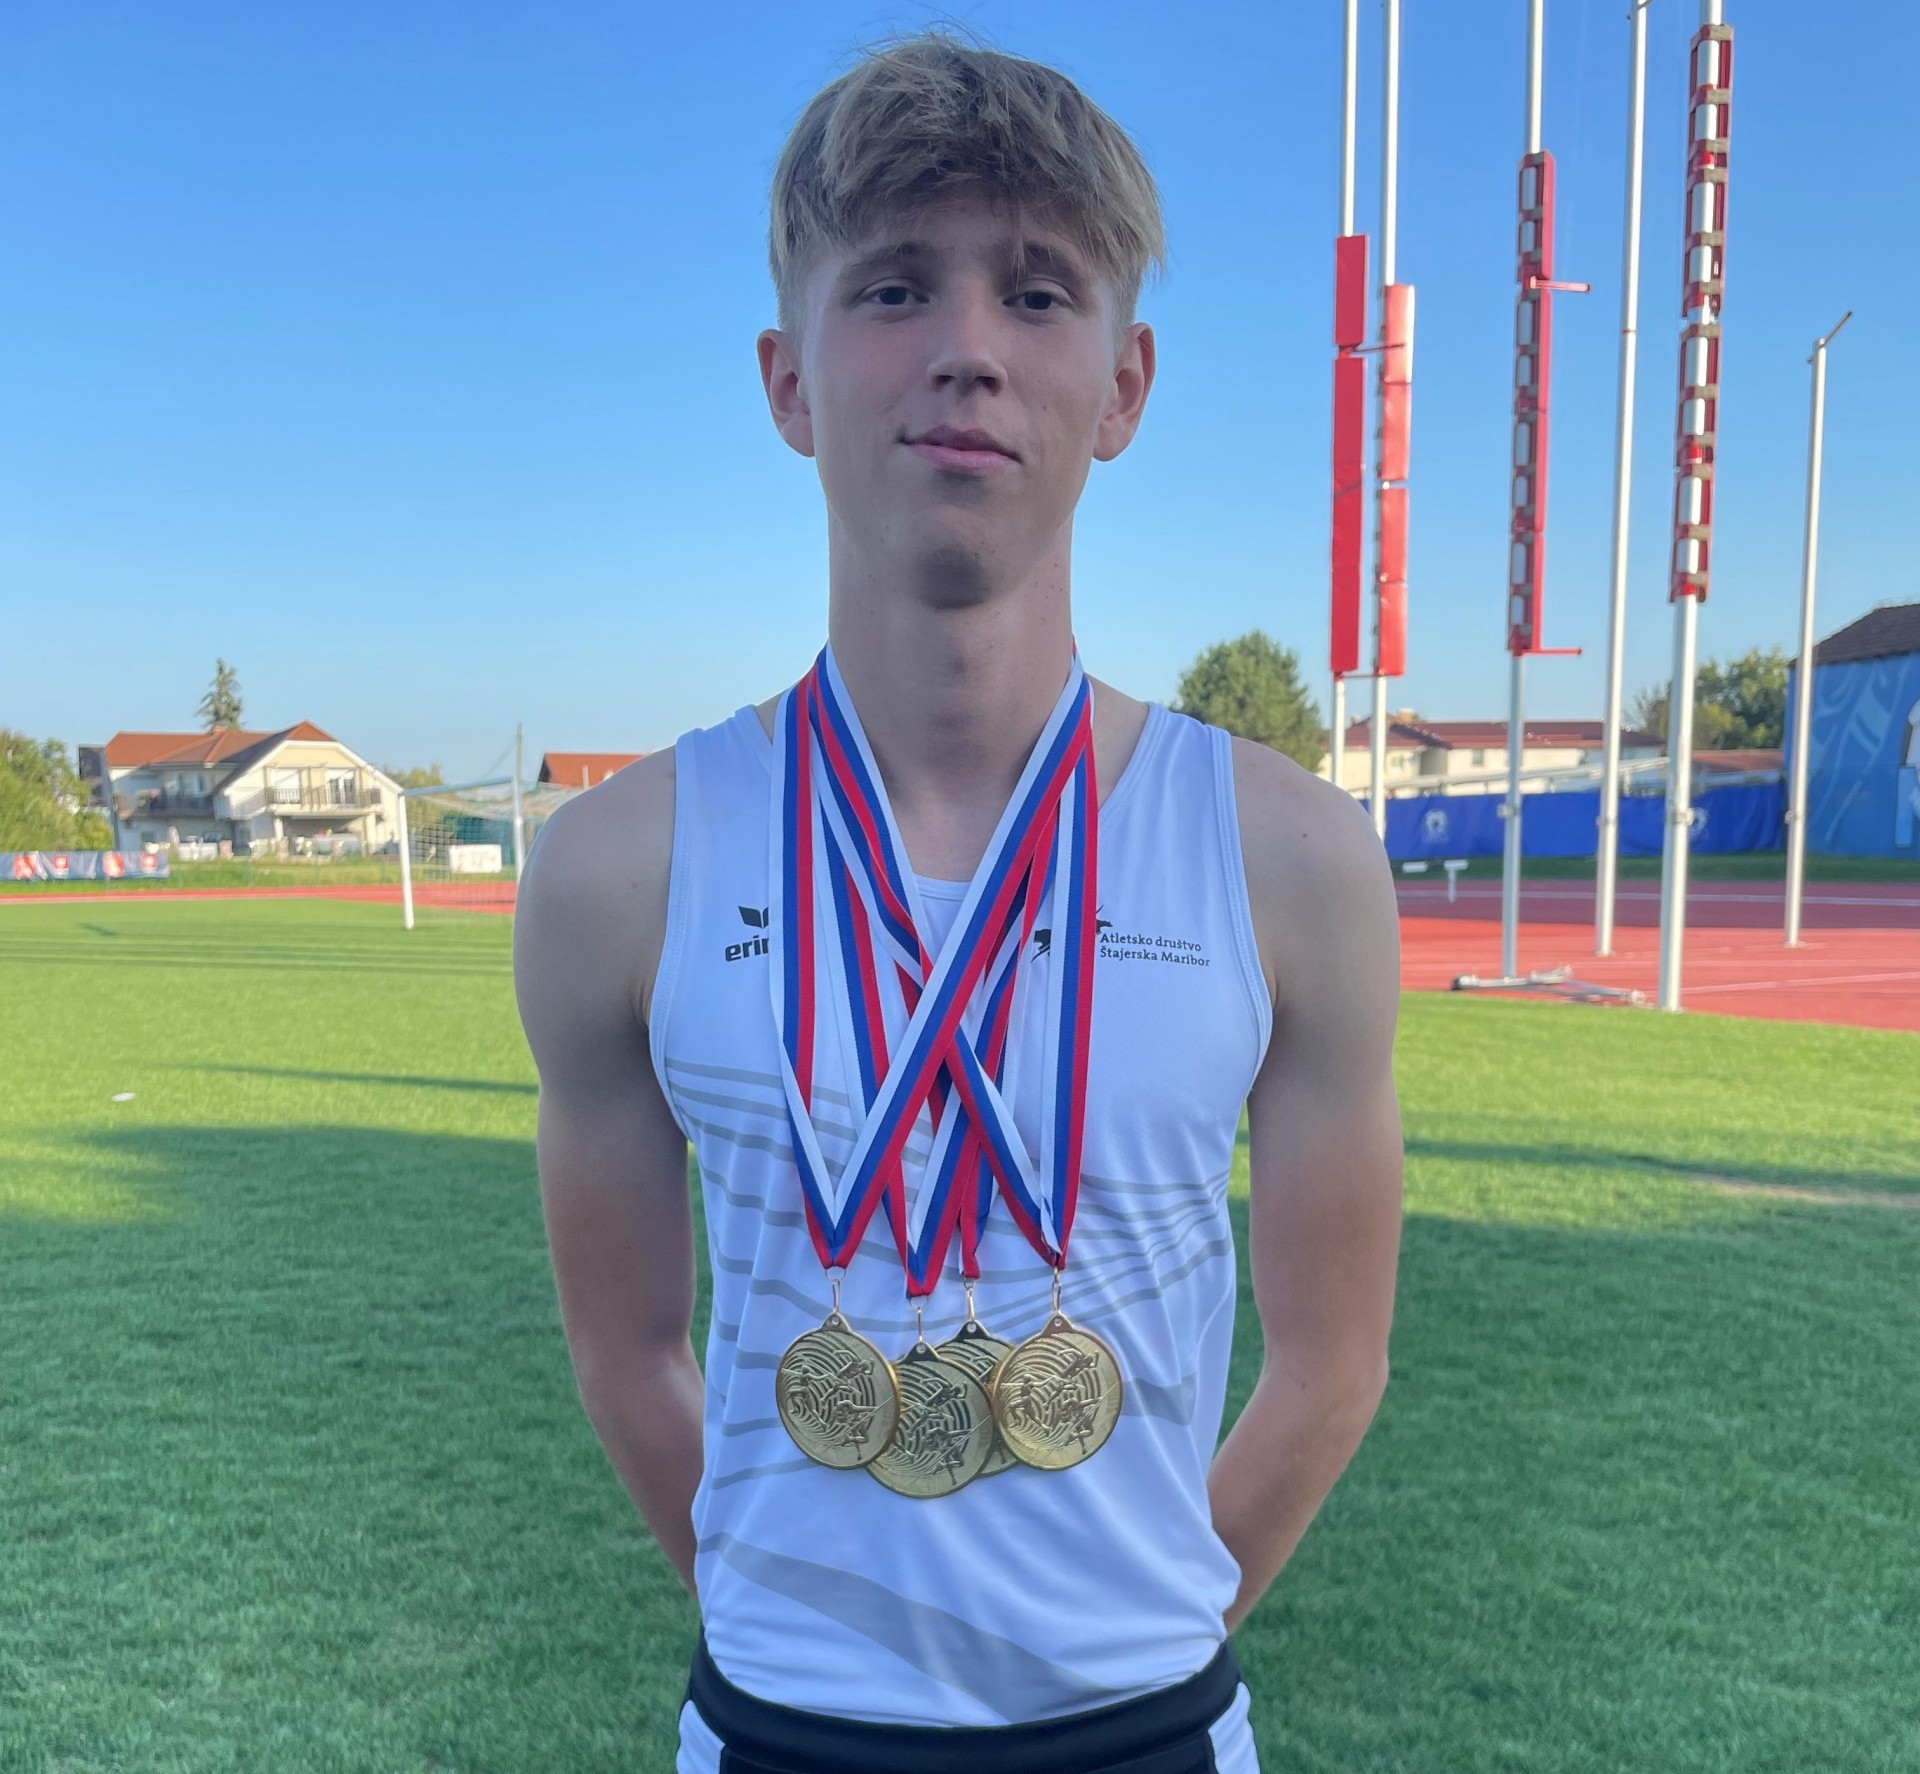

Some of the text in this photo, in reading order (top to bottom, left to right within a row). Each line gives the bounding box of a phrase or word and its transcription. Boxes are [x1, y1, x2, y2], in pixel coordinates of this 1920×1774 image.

[1100, 933, 1202, 952] Atletsko društvo
[1100, 946, 1210, 966] Štajerska Maribor
